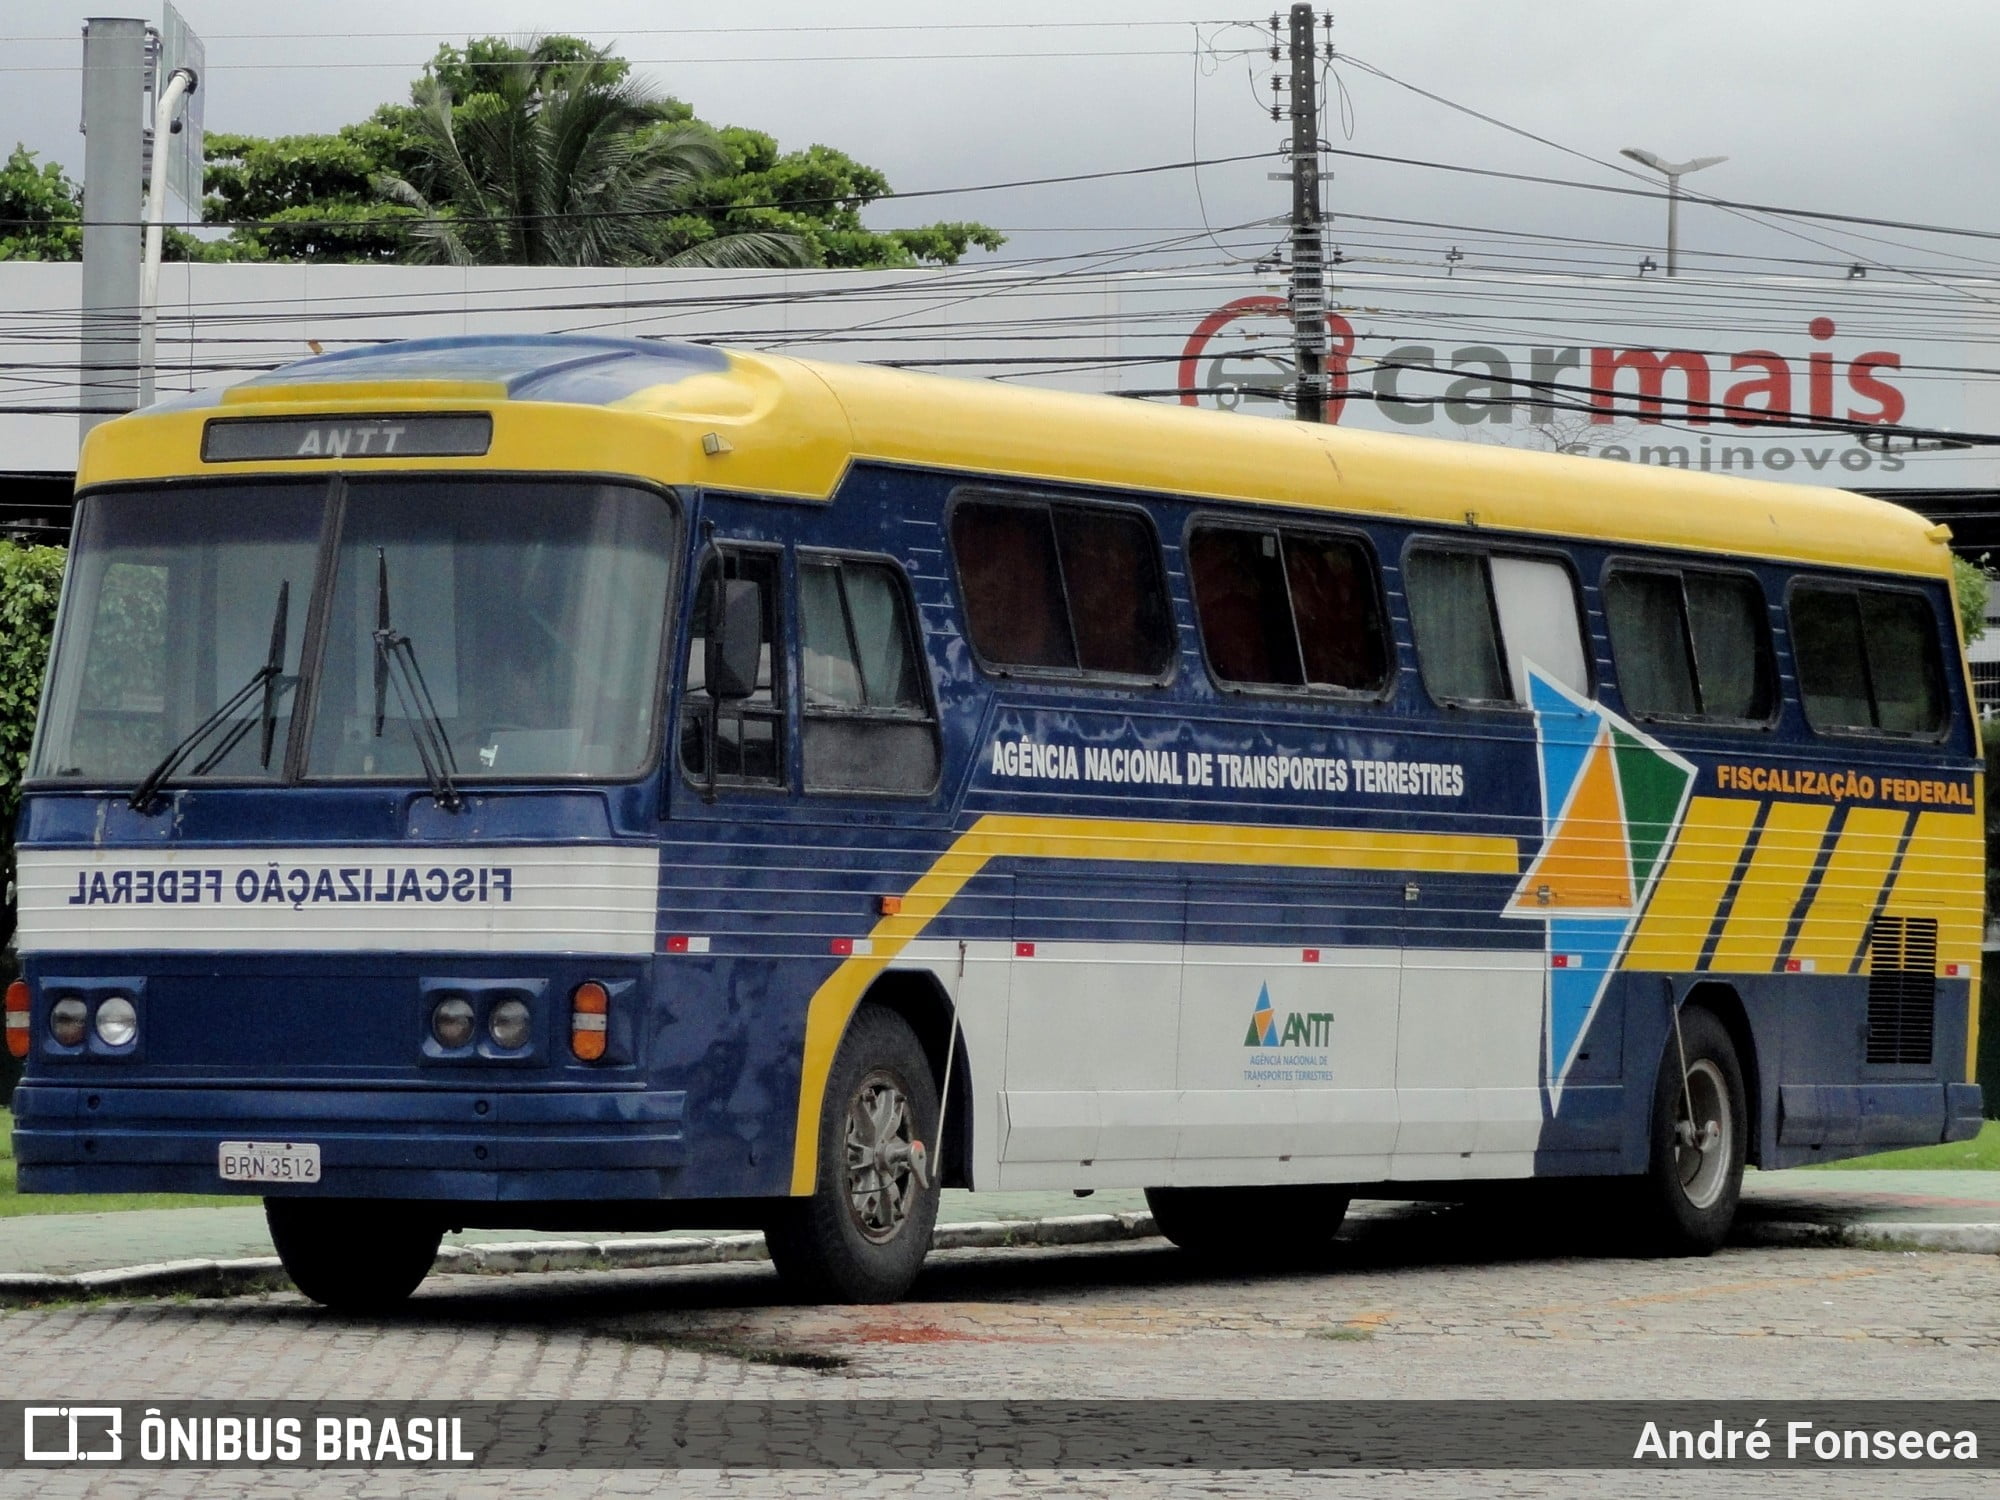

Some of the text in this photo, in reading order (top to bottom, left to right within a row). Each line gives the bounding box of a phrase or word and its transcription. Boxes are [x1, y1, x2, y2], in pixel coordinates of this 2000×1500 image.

[1372, 317, 1906, 428] carmais
[296, 426, 405, 457] ANTT
[992, 735, 1464, 796] AGÊNCIA NACIONAL DE TRANSPORTES TERRESTRES
[1717, 765, 1973, 805] FISCALIZAÇÃO FEDERAL
[1280, 1012, 1334, 1047] ANTT
[1244, 1070, 1333, 1081] TRANSPORTES TERRESTRES
[1250, 1053, 1328, 1066] AGÊNCIA NACIONAL DE
